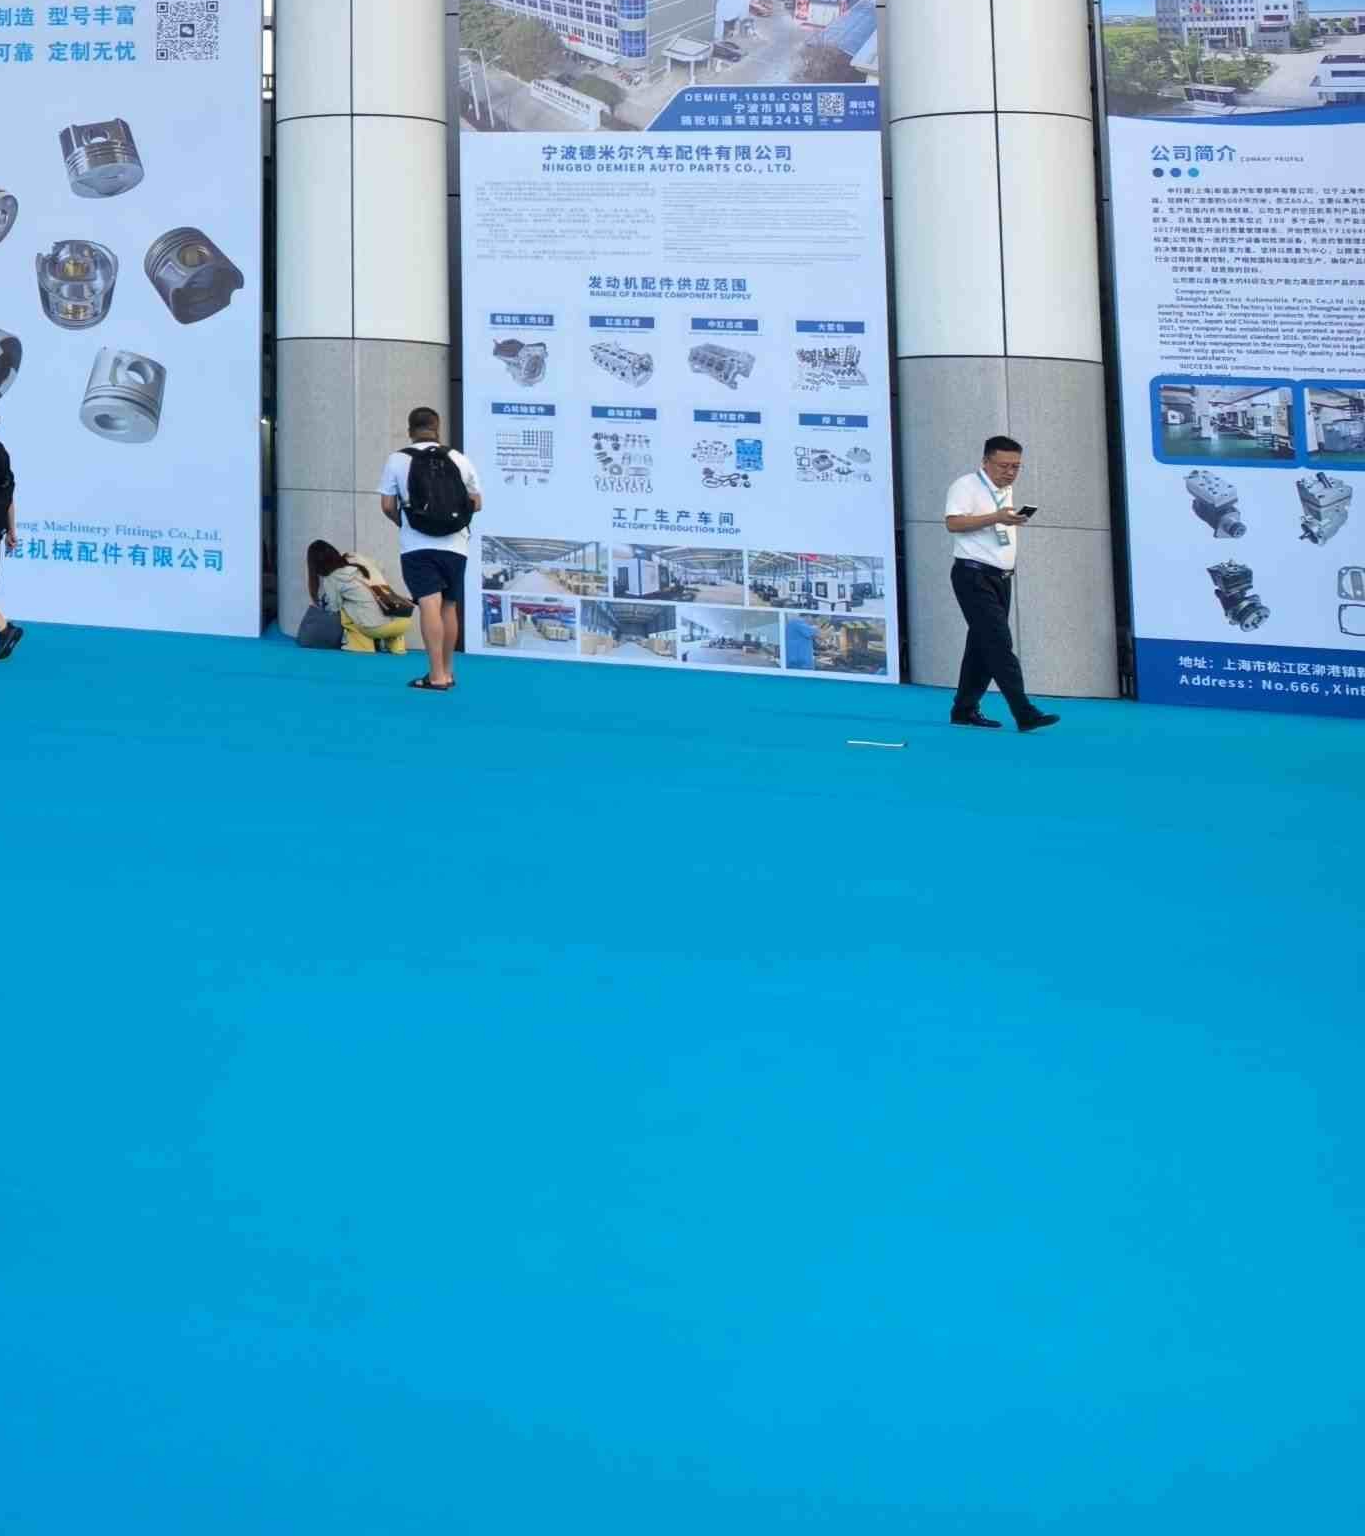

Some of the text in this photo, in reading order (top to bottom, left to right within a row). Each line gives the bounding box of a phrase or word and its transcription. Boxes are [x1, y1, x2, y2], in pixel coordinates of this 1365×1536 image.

[47, 5, 136, 26] 型号丰富
[47, 41, 137, 63] 定制无忧
[541, 145, 792, 161] 宁波德米尔汽车配件有限公司
[1151, 145, 1237, 162] 公司简介
[542, 162, 593, 174] NINGBO
[596, 163, 646, 174] DEMIER
[649, 163, 685, 174] AUTO
[689, 163, 731, 174] PARTS
[588, 276, 748, 293] 发动机配件供应范围
[612, 507, 734, 526] 工厂生产车间
[42, 519, 109, 537] Machinery
[115, 524, 165, 540] Fittings
